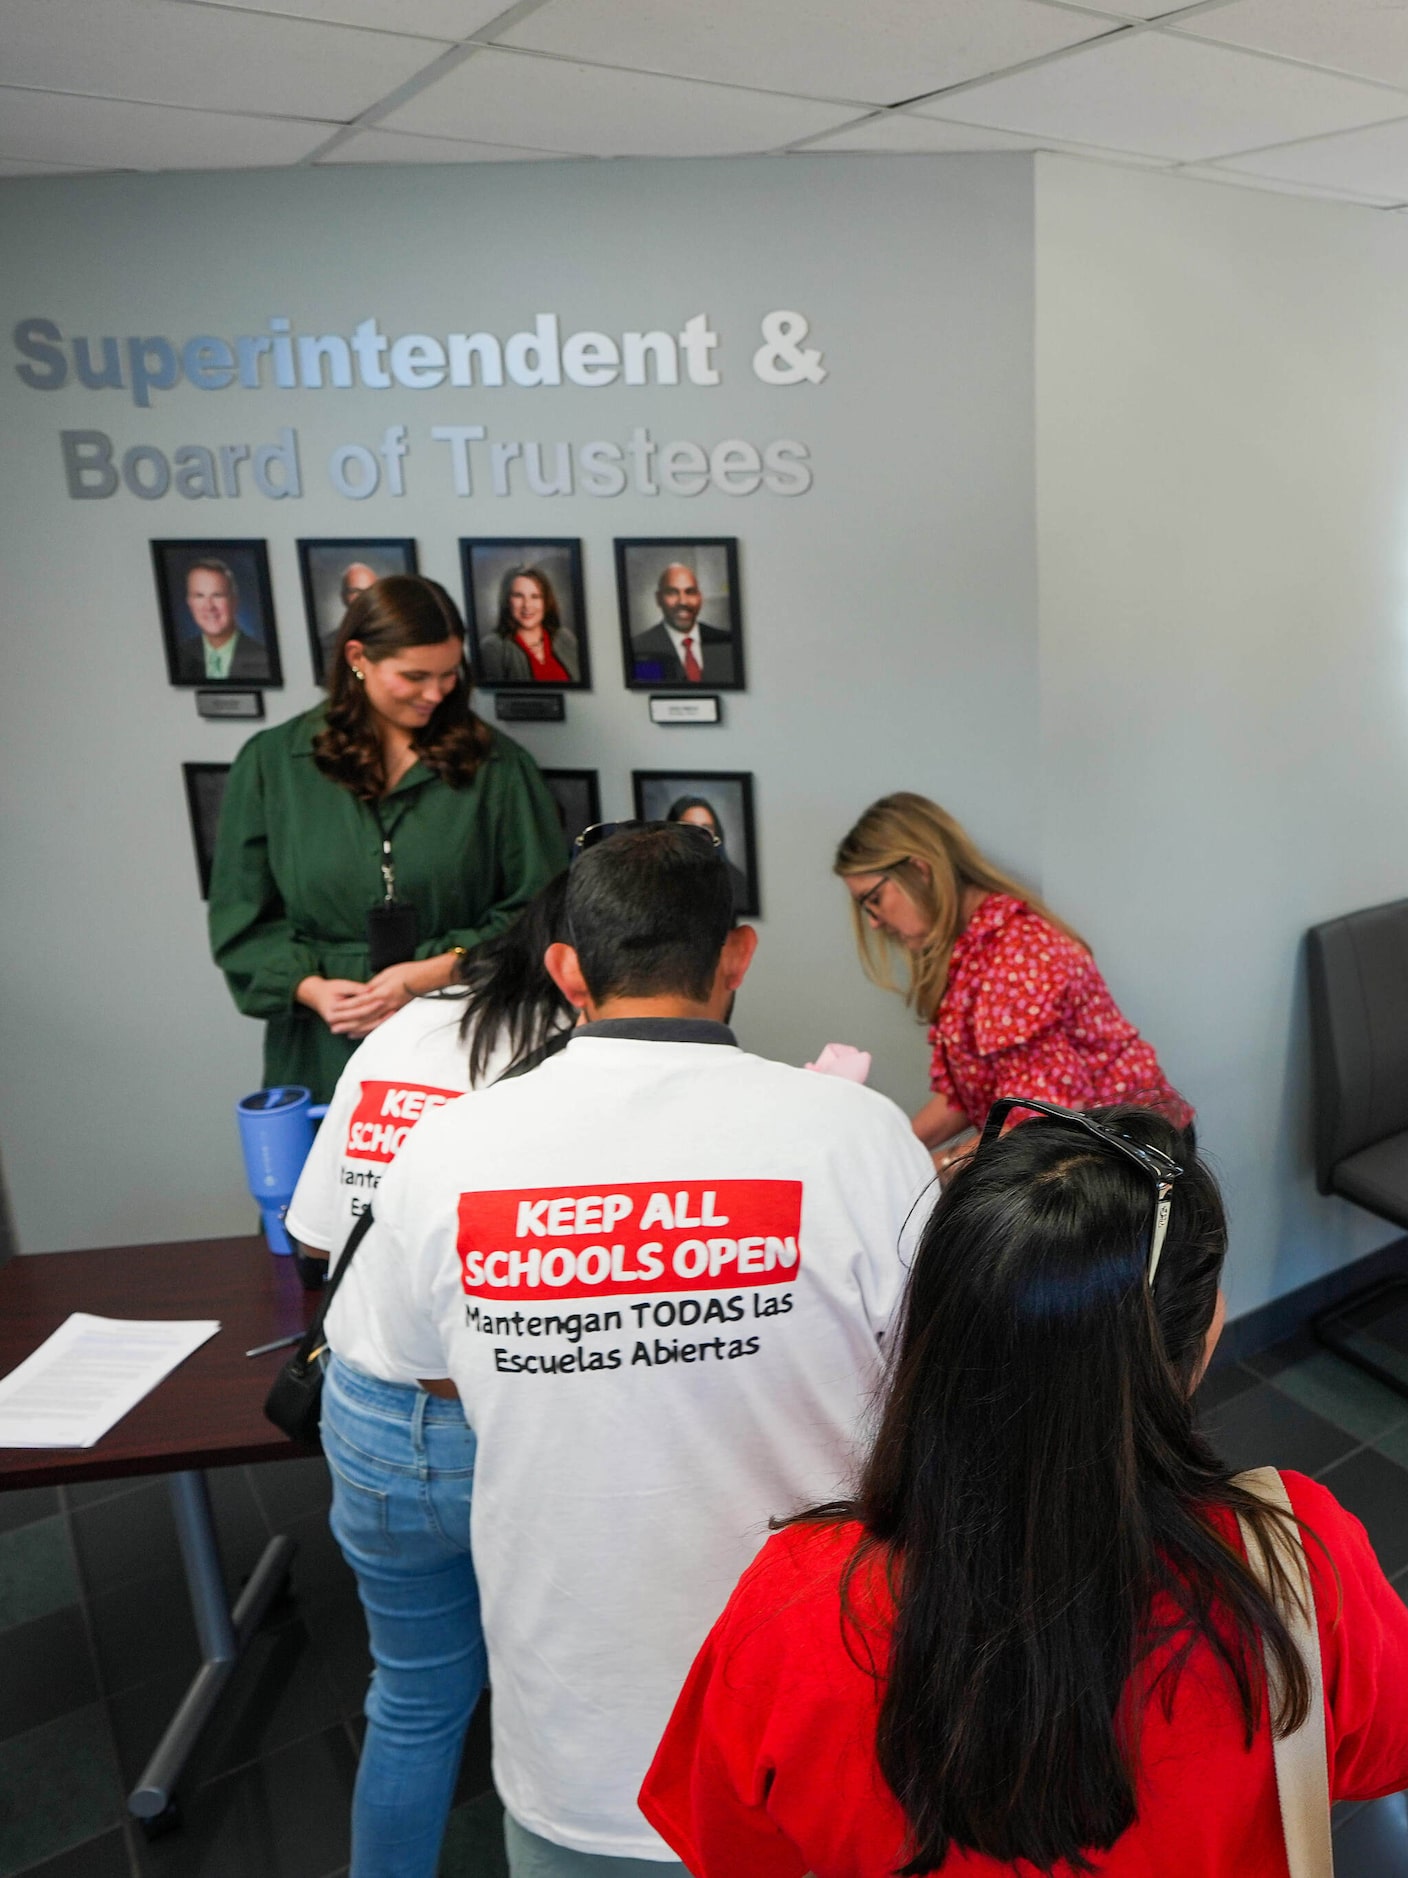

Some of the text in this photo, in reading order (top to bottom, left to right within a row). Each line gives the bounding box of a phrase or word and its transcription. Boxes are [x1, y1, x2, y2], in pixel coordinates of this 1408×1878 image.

[13, 310, 829, 408] Superintendent &
[59, 424, 814, 501] Board of Trustees
[381, 1088, 448, 1121] KEE
[348, 1122, 411, 1155] SCHO
[516, 1191, 729, 1238] KEEP ALL
[464, 1236, 799, 1288] SCHOOLS OPEN
[465, 1292, 794, 1343] Mantengan TODAS las
[493, 1335, 761, 1375] Escuelas Abiertas
